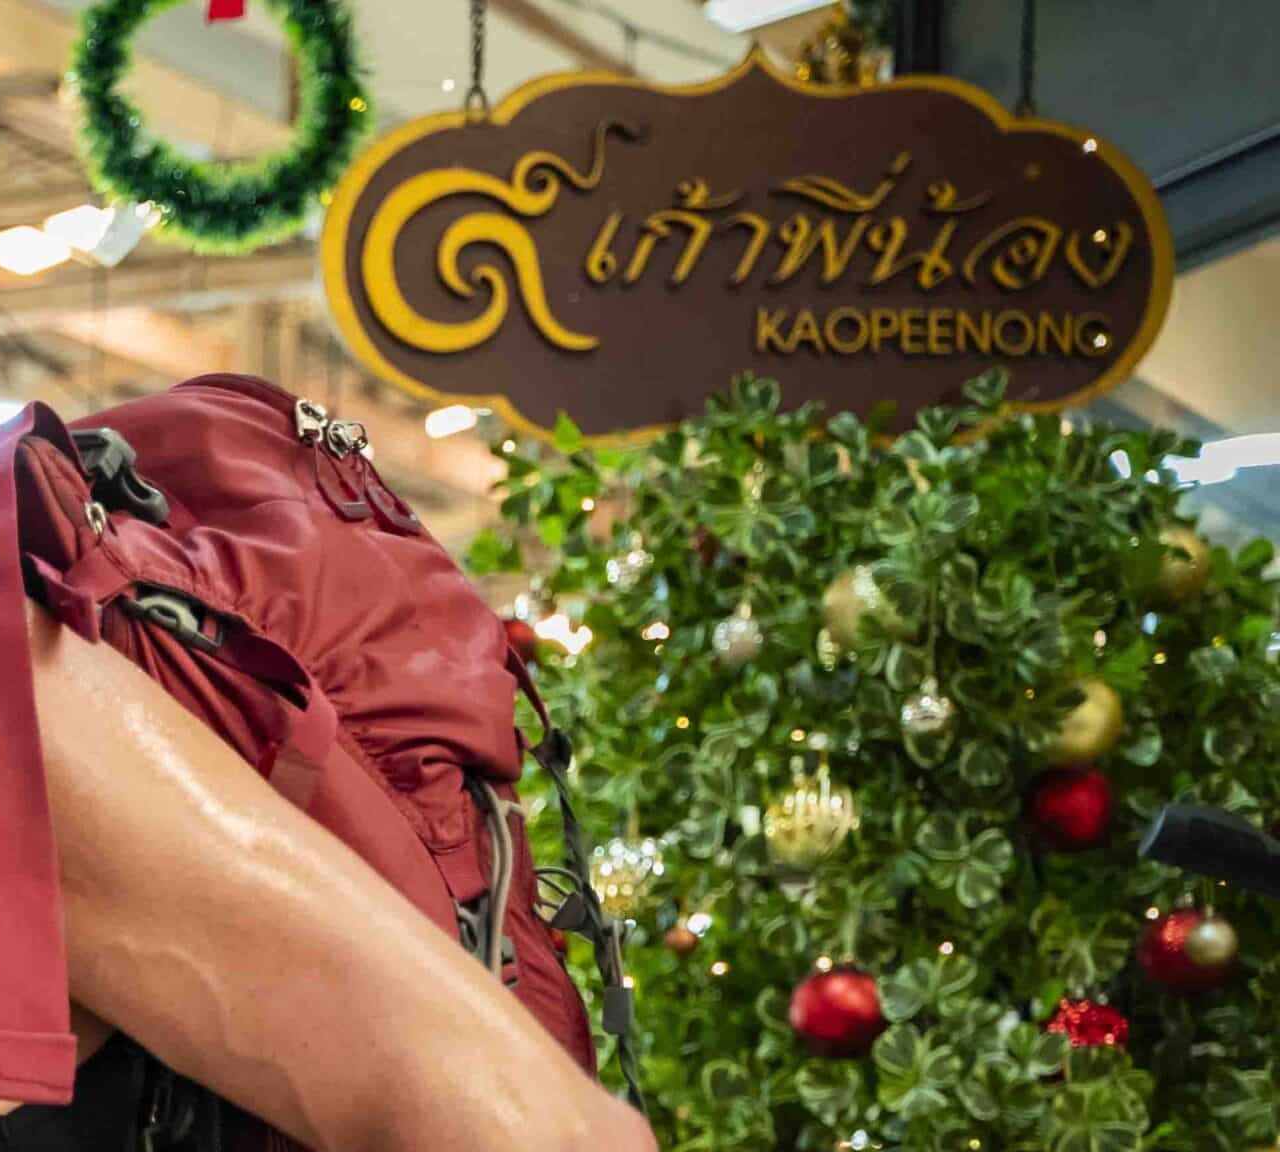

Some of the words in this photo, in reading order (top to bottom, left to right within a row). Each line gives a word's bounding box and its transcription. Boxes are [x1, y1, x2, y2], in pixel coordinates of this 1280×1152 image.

[585, 149, 1133, 290] เก้าพี่น้อง
[755, 307, 1111, 356] KAOPEENONG
